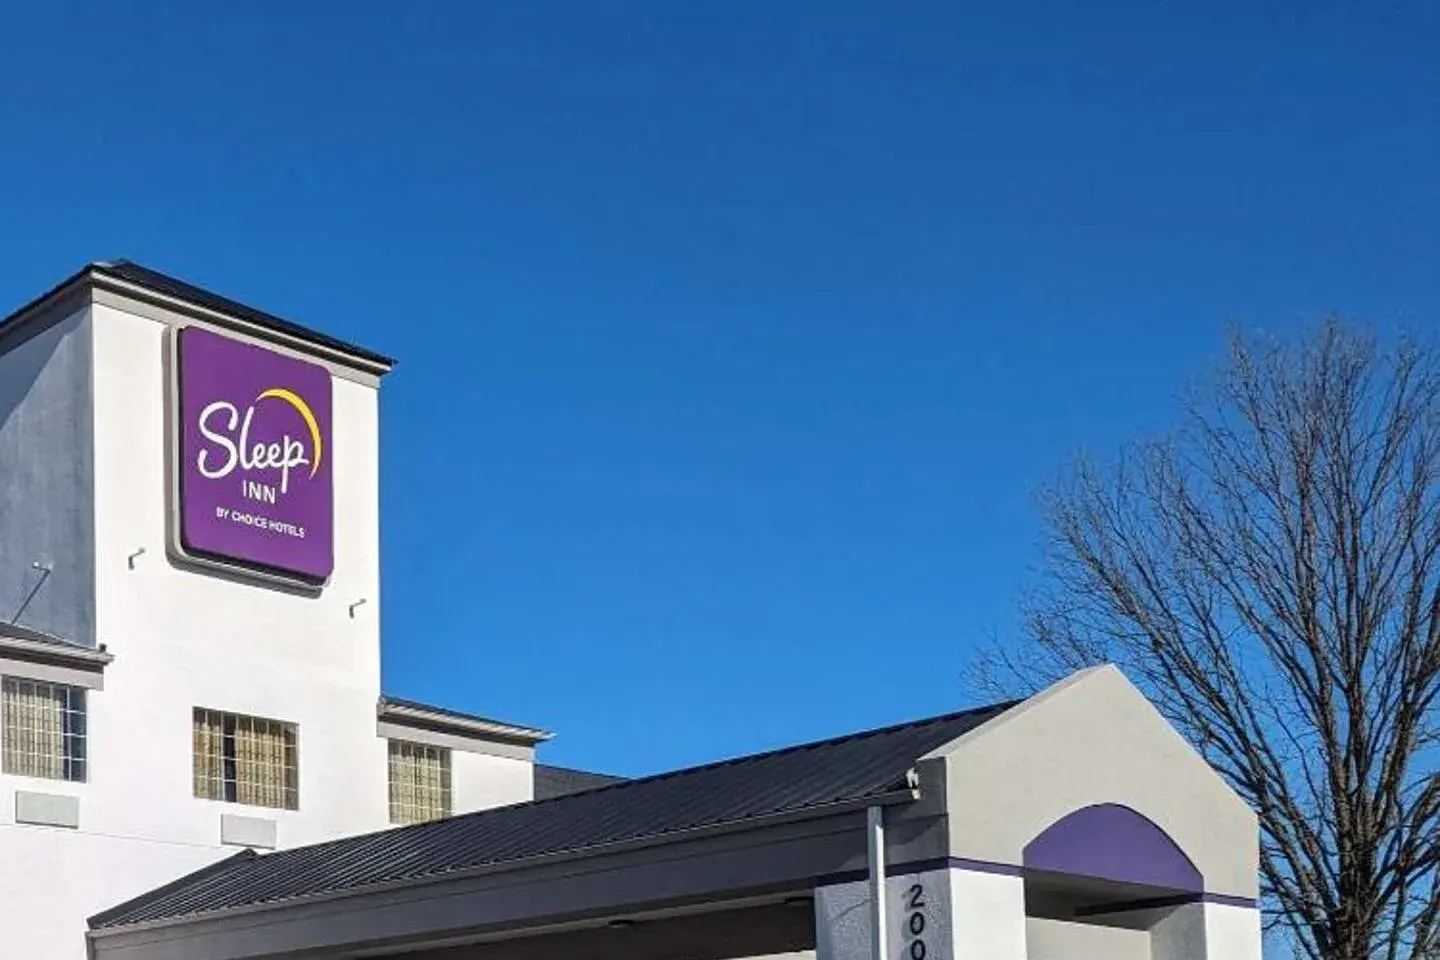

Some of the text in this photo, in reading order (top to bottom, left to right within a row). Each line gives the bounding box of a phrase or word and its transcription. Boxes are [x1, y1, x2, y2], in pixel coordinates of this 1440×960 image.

[197, 402, 309, 493] Sleep
[243, 479, 276, 504] INN
[216, 506, 304, 538] BY CHOICE HOTELS
